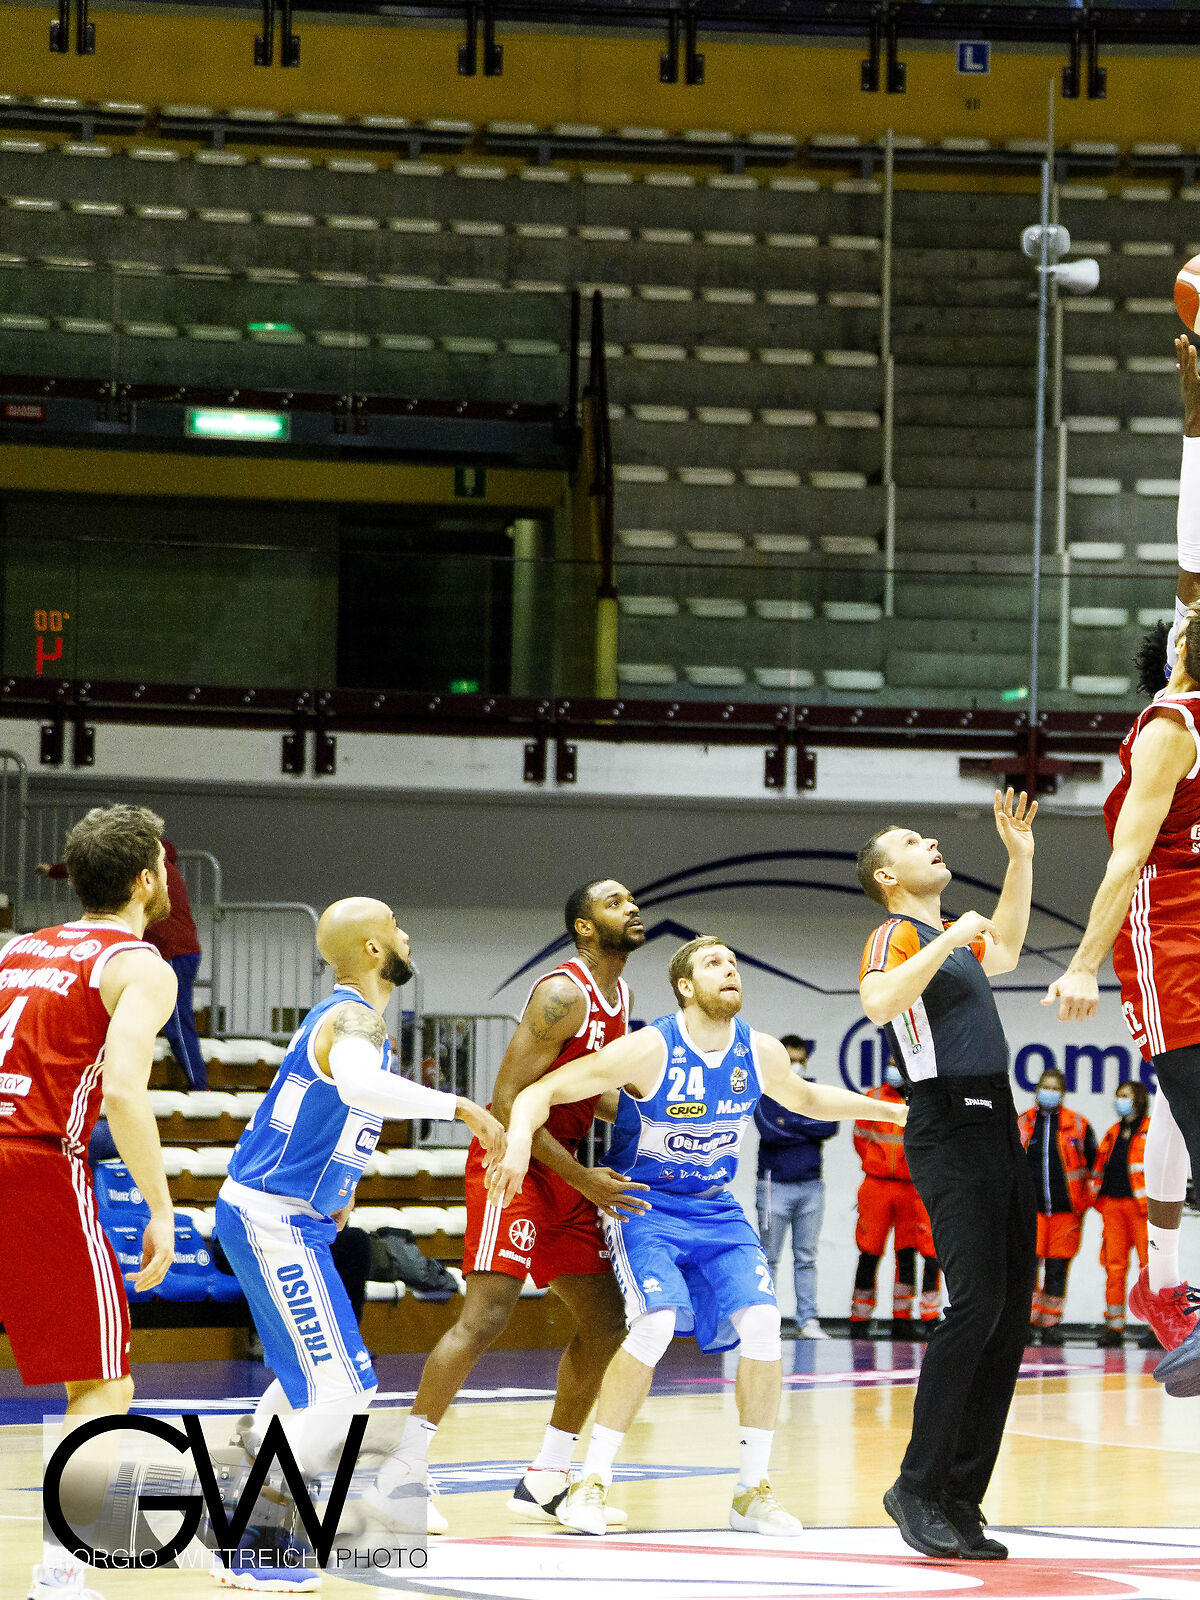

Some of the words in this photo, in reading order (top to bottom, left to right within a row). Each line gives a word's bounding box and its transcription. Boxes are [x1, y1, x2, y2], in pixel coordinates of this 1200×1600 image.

[964, 46, 984, 70] L
[586, 1020, 606, 1052] 15
[666, 1066, 706, 1102] 24
[669, 1105, 704, 1116] CRICH
[277, 1263, 333, 1366] TREVISO
